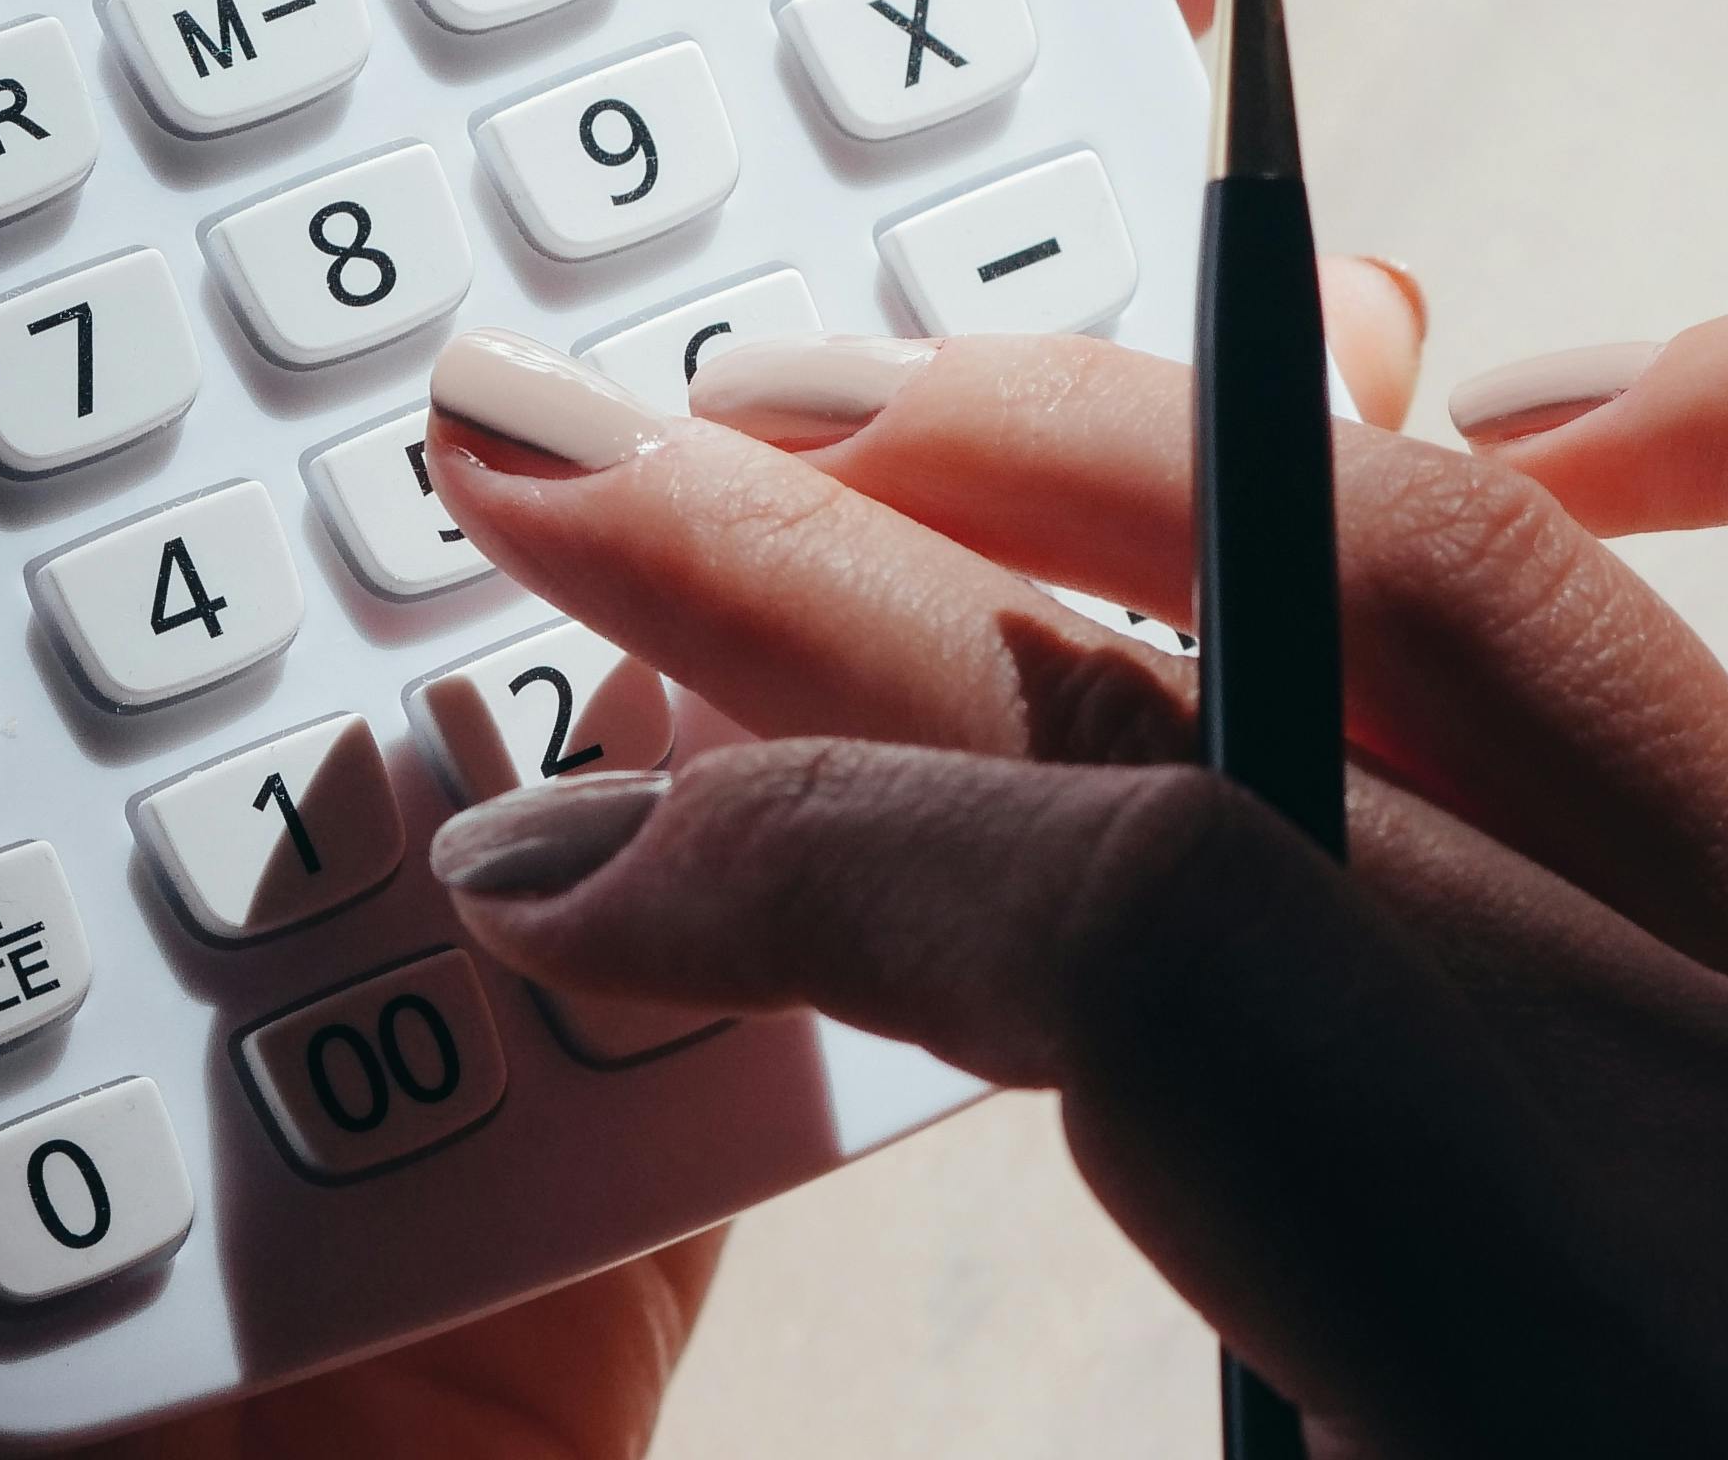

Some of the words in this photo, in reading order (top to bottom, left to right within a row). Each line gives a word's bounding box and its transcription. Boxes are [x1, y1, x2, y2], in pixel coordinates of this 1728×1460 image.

[578, 98, 659, 206] 9
[308, 200, 397, 308] 8
[26, 301, 94, 419] 7
[150, 536, 228, 639] 4
[508, 665, 605, 780] 2
[251, 772, 325, 875] 1
[306, 993, 461, 1135] 00
[26, 1139, 112, 1250] 0
